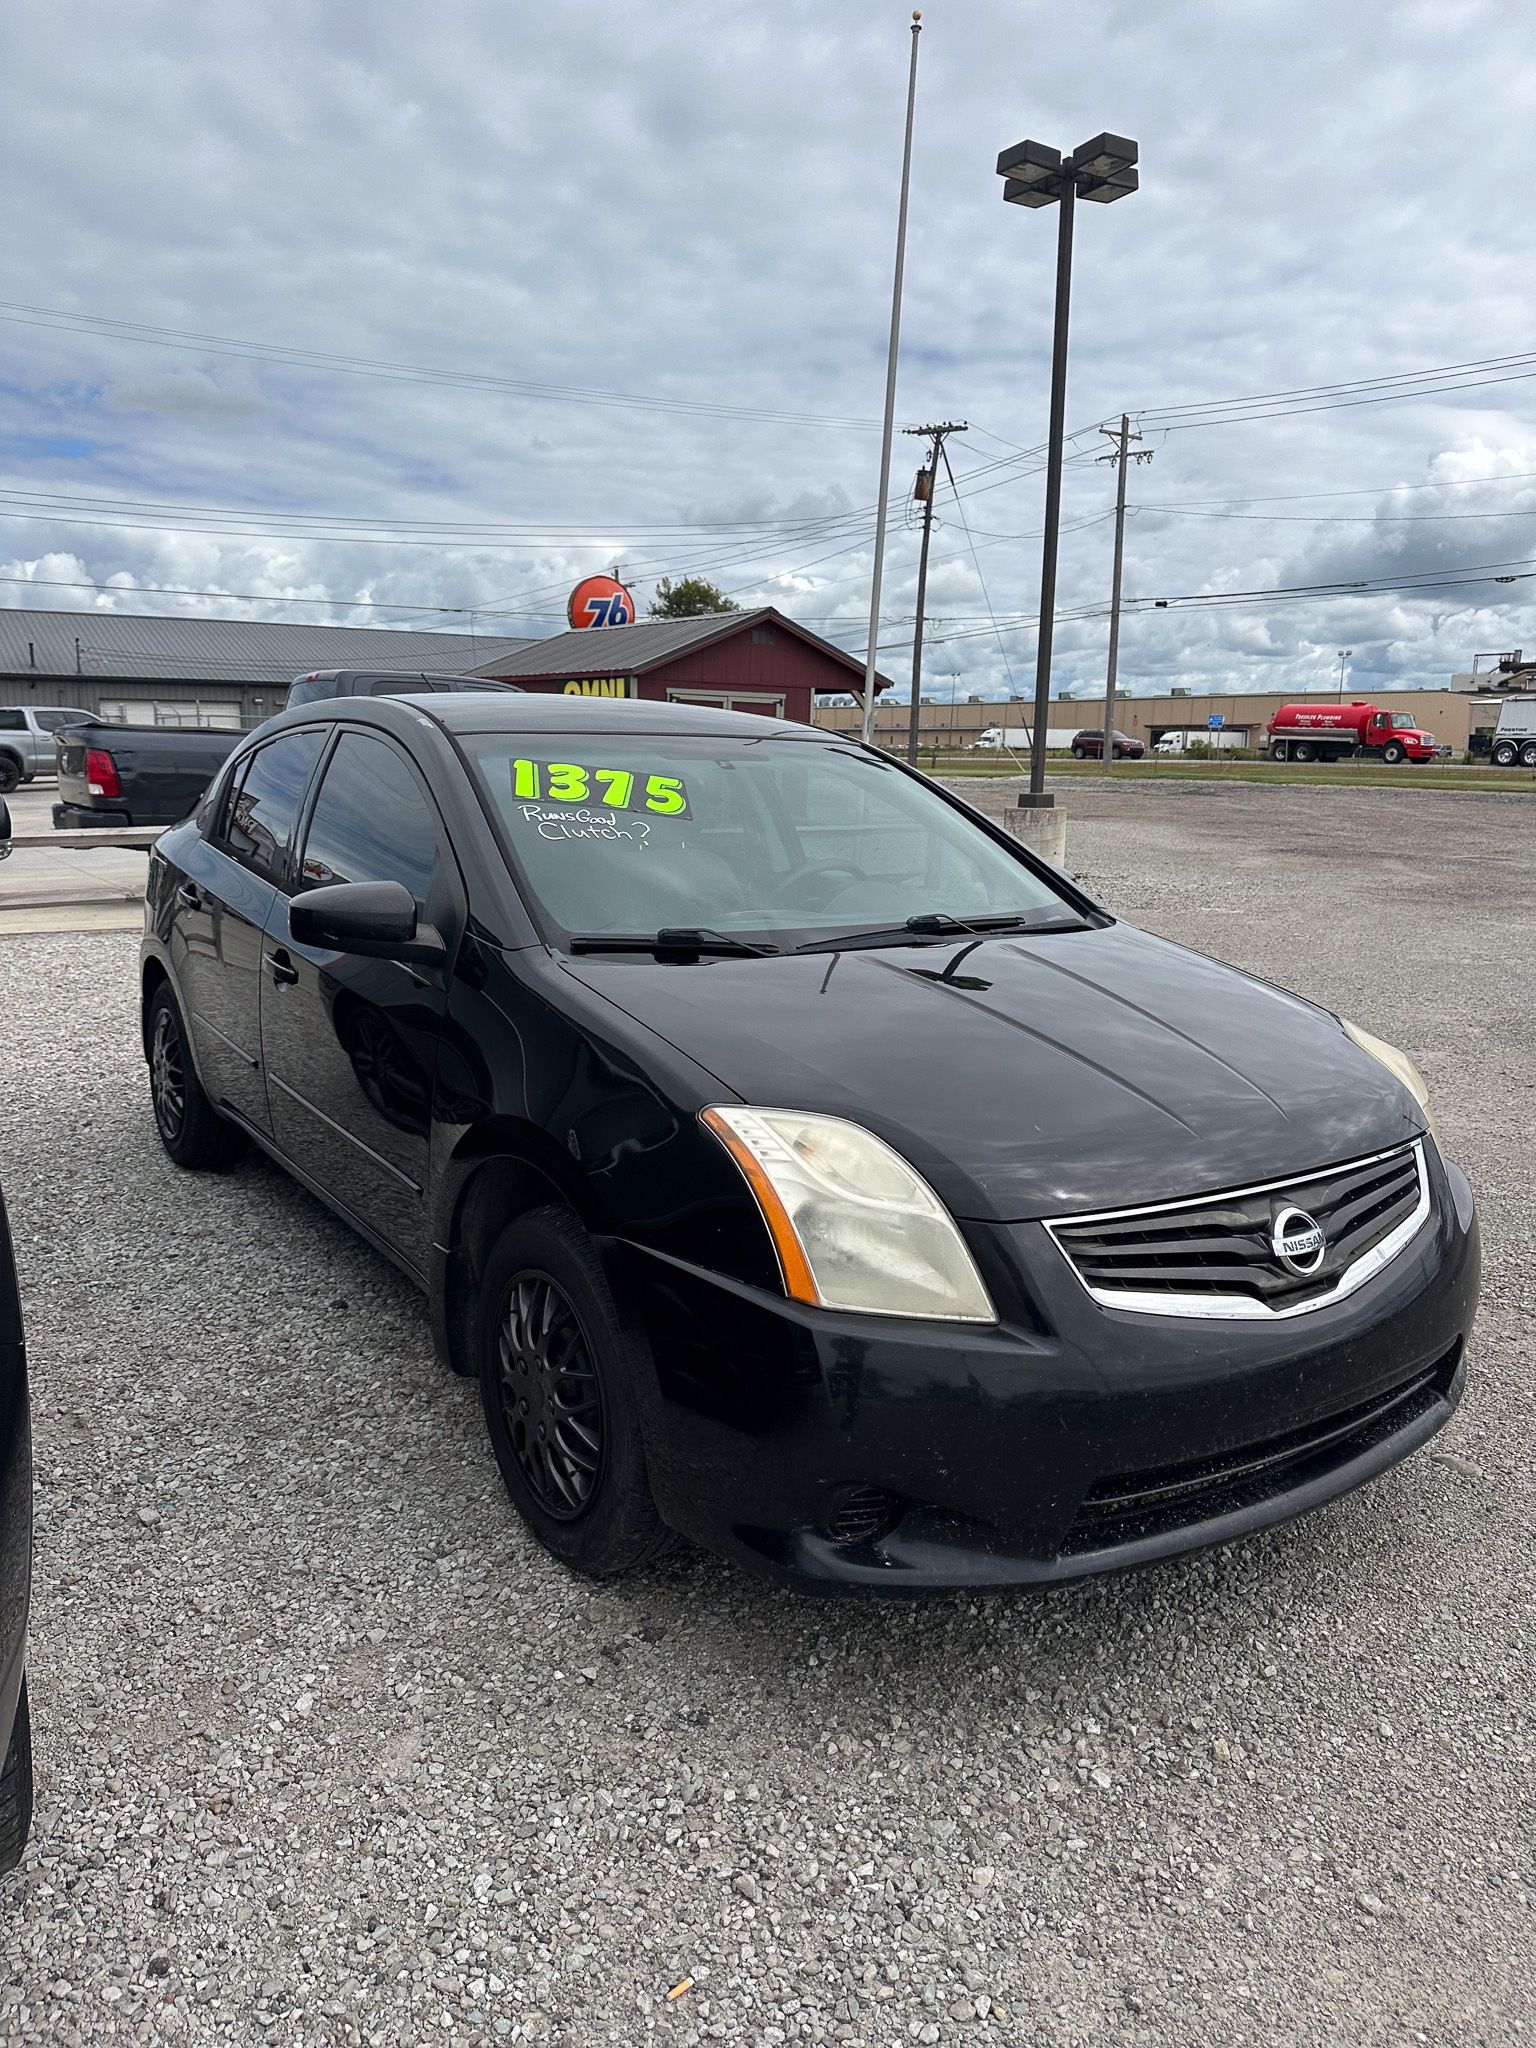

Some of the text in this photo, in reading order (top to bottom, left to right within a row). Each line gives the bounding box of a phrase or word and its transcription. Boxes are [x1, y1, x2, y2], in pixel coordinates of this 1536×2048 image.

[583, 592, 628, 628] 76
[513, 759, 687, 815] 1375
[537, 821, 651, 846] Clutch?
[1282, 1231, 1323, 1253] NISSAN
